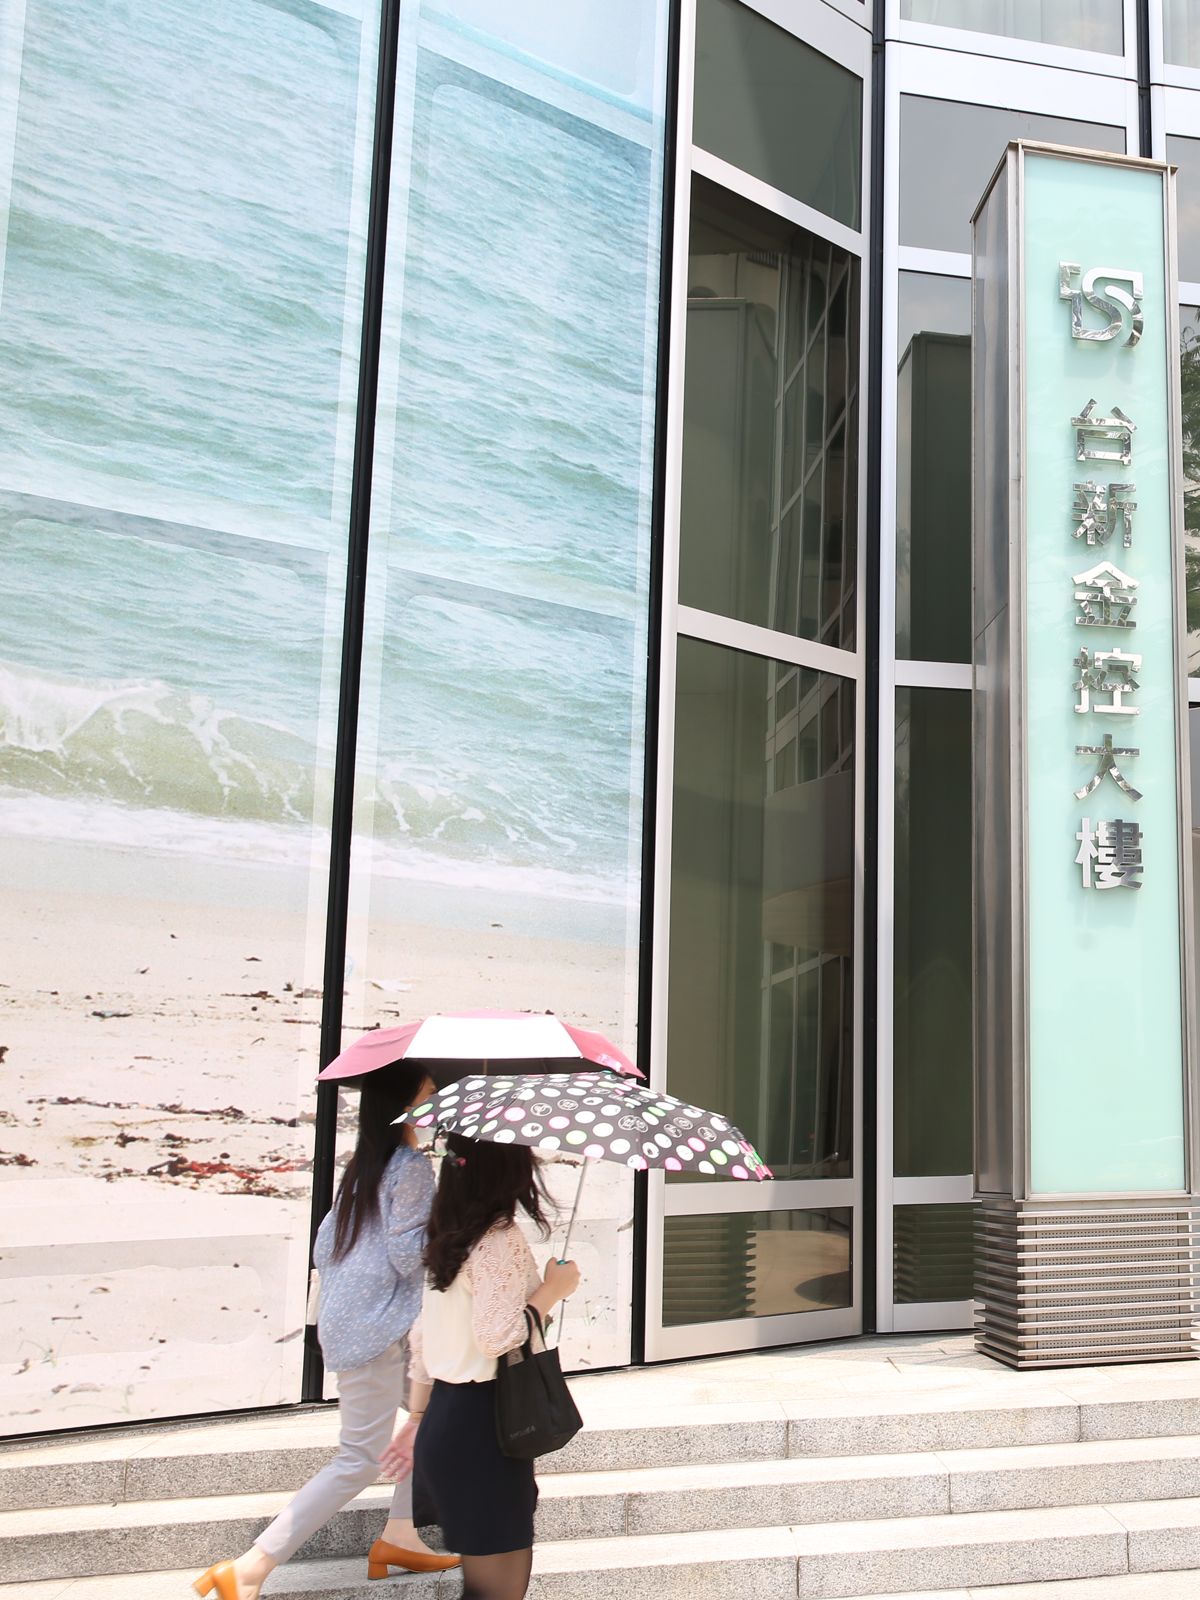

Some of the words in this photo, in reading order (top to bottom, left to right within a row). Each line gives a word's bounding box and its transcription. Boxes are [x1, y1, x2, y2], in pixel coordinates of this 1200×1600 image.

[1069, 398, 1144, 890] 台新金控大樓
